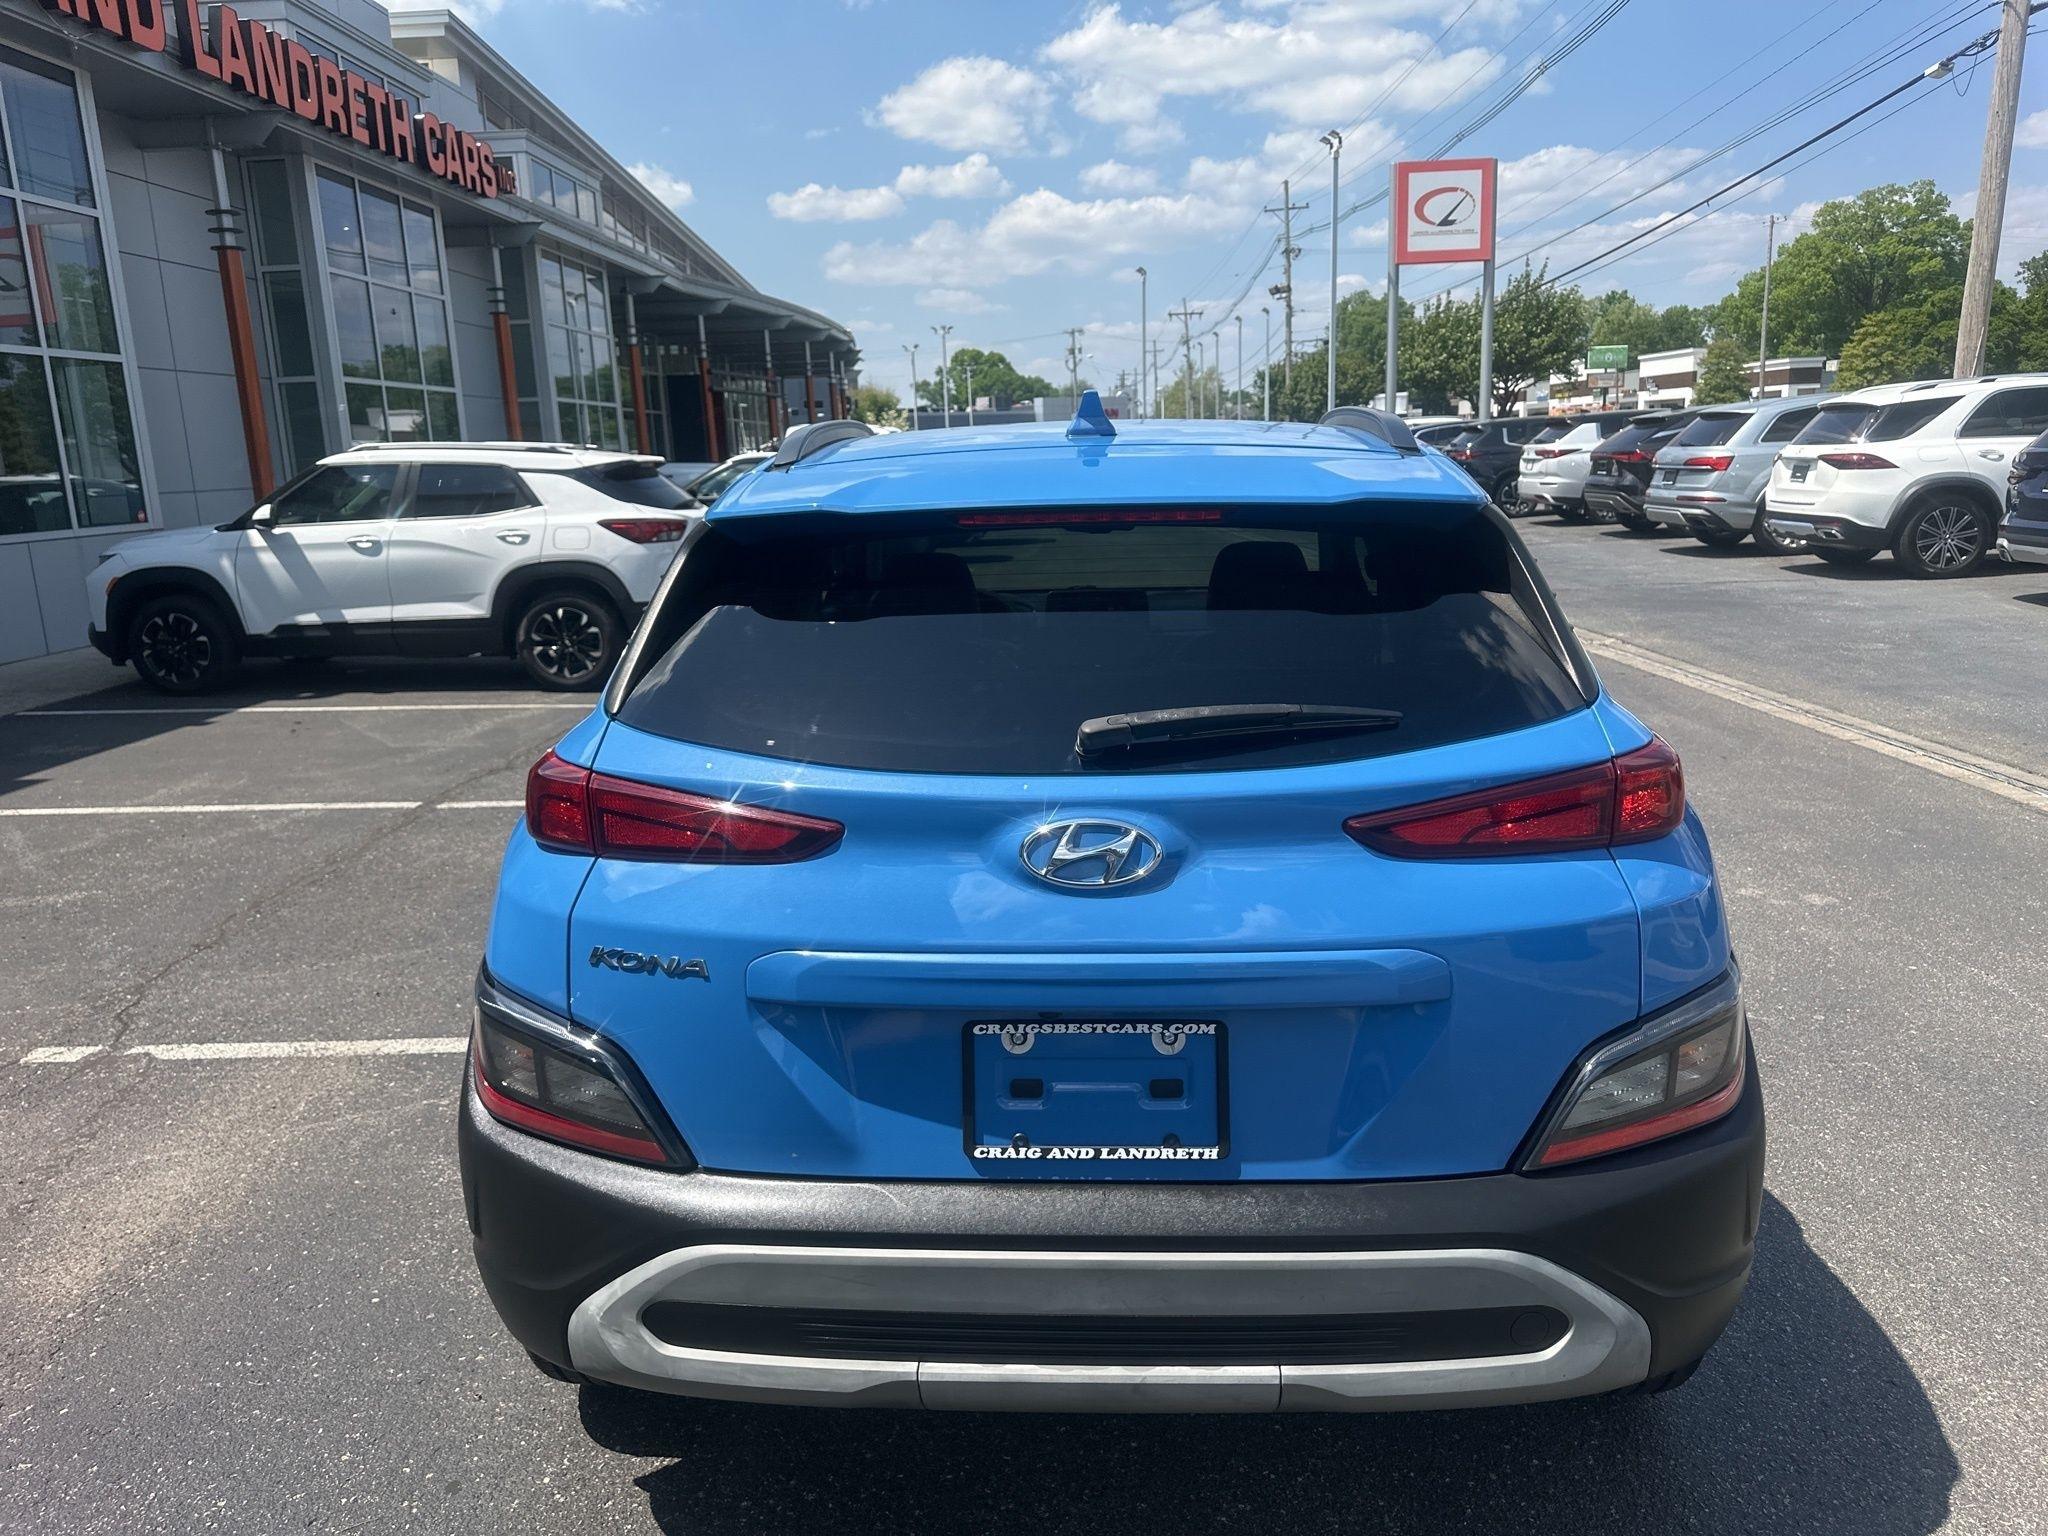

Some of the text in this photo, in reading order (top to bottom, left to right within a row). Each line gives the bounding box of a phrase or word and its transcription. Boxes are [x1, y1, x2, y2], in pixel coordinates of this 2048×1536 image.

[187, 0, 415, 164] LANDRETH
[423, 111, 498, 199] CARS
[589, 945, 712, 983] KONA
[973, 1023, 1217, 1035] CRAIGSBESTCARS.COM
[973, 1147, 1219, 1160] CRAIG AND LANDRETH
